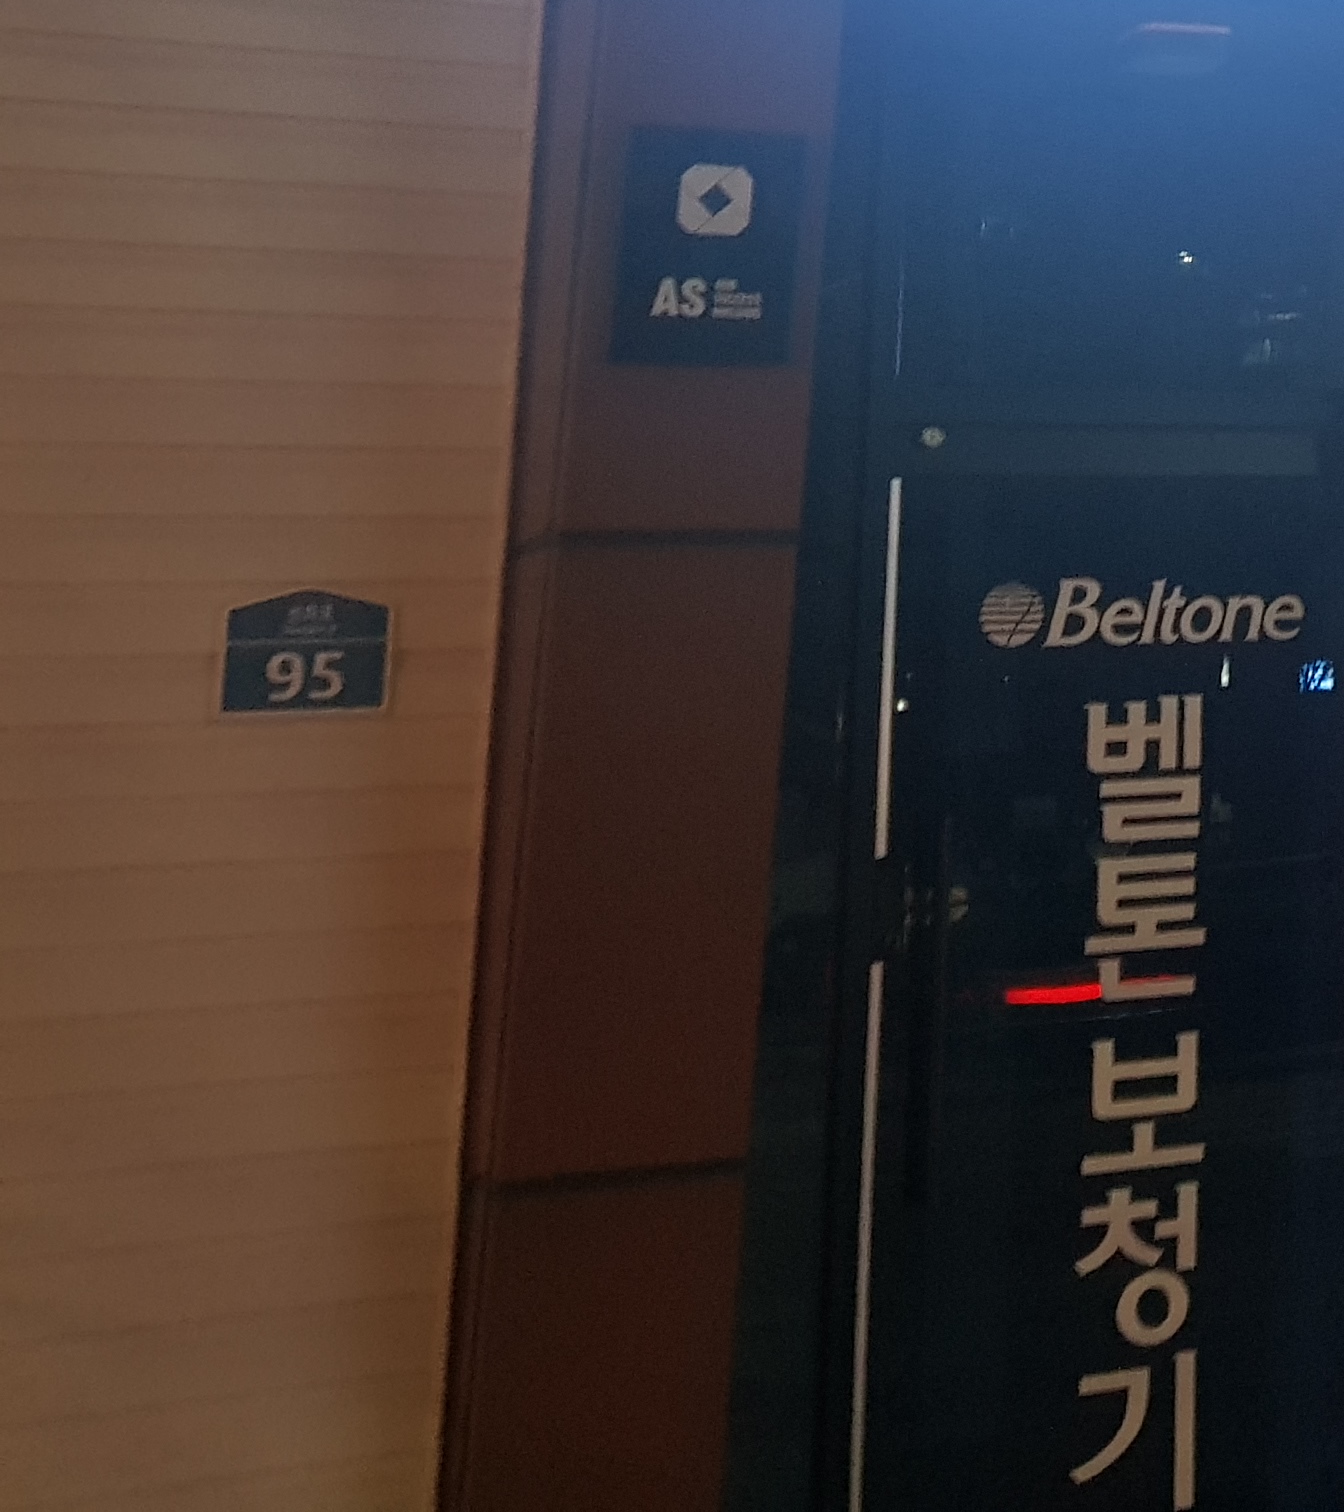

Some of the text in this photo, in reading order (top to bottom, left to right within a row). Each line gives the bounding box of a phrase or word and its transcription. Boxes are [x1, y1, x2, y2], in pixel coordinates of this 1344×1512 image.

[649, 276, 707, 317] AS
[1043, 577, 1305, 649] Beltone
[265, 651, 345, 702] 95
[1084, 693, 1206, 1005] 벨톤
[1069, 1029, 1206, 1511] 보청기
